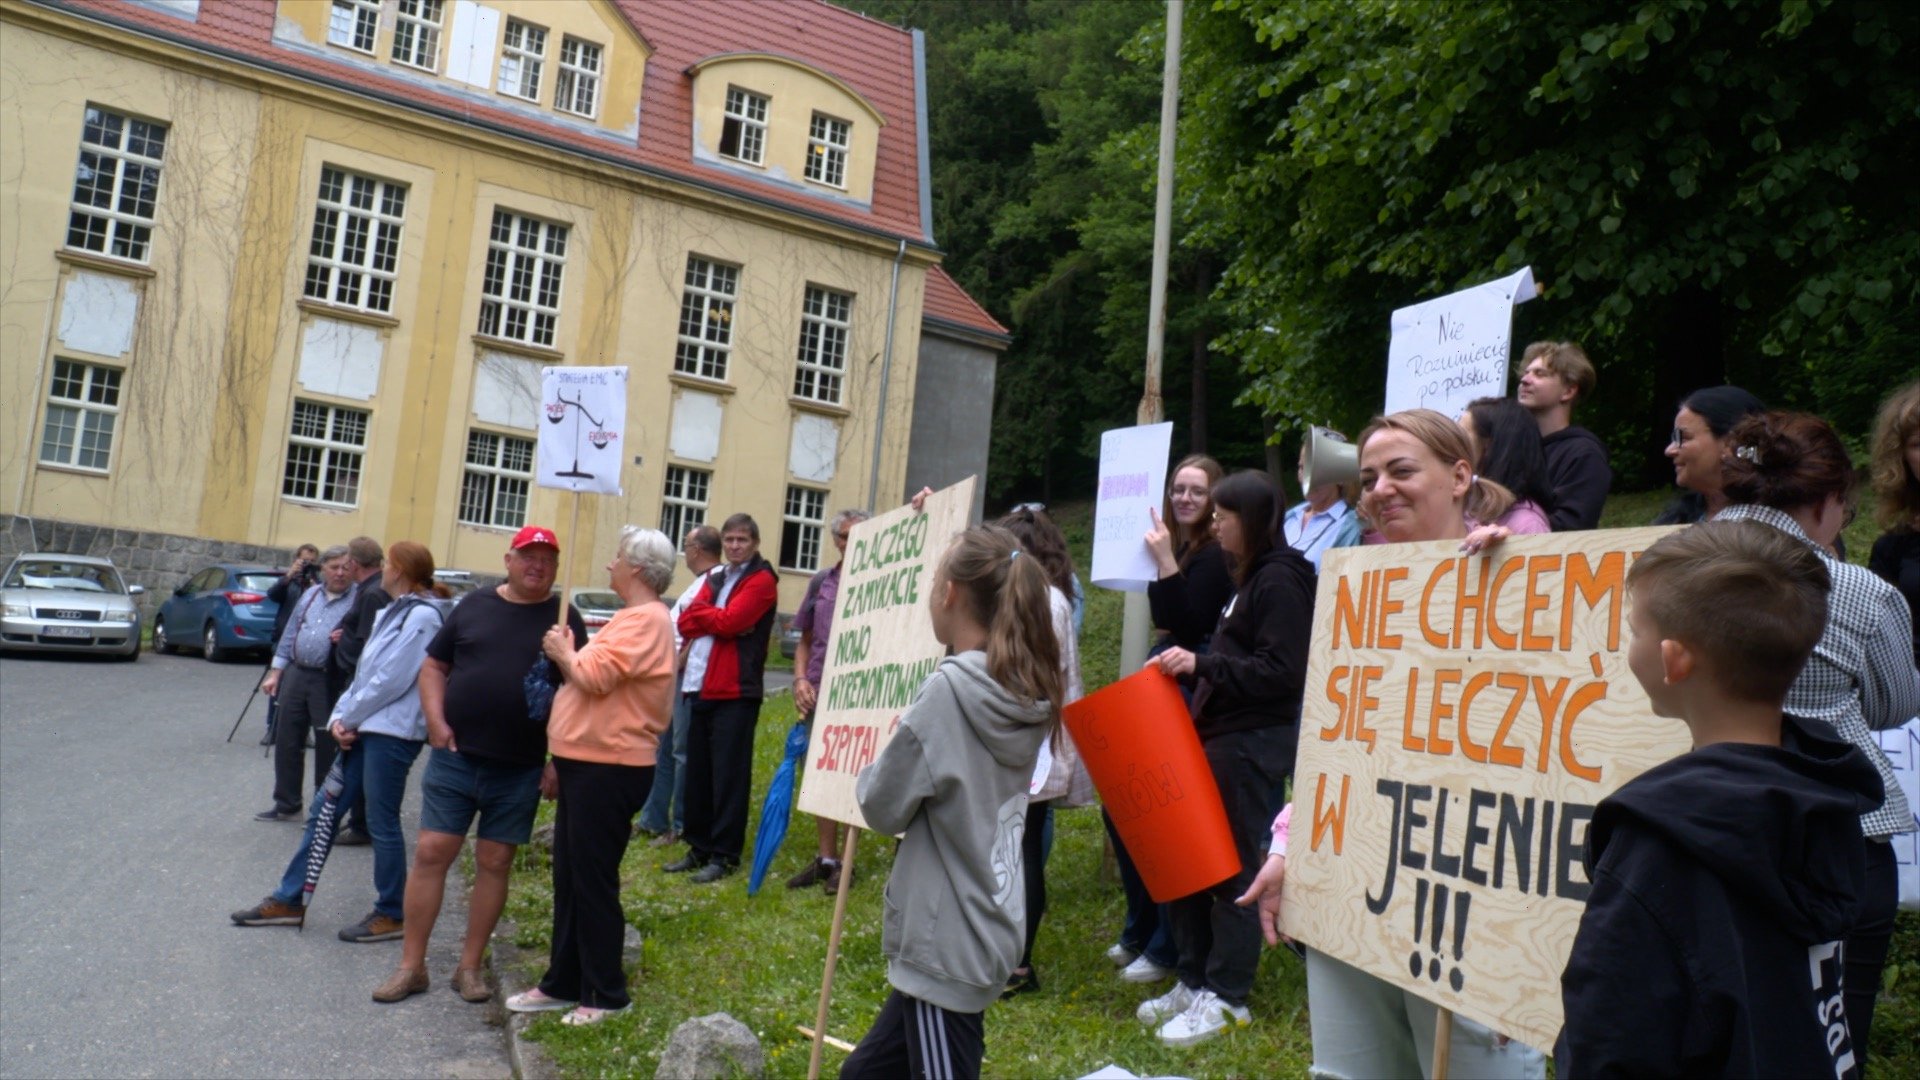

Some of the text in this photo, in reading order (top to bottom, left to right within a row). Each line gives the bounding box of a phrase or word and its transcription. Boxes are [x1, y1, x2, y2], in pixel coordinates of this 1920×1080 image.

[1437, 312, 1465, 345] Nie
[1416, 381, 1439, 409] po
[850, 512, 928, 575] DLACZEGO
[842, 564, 923, 619] ZAMYKACIE
[1331, 551, 1641, 651] NIE CHCEM
[834, 625, 871, 667] NOWO
[1320, 652, 1608, 781] SIĘ LECZYĆ
[1310, 773, 1351, 856] W
[1409, 877, 1471, 992] !!!
